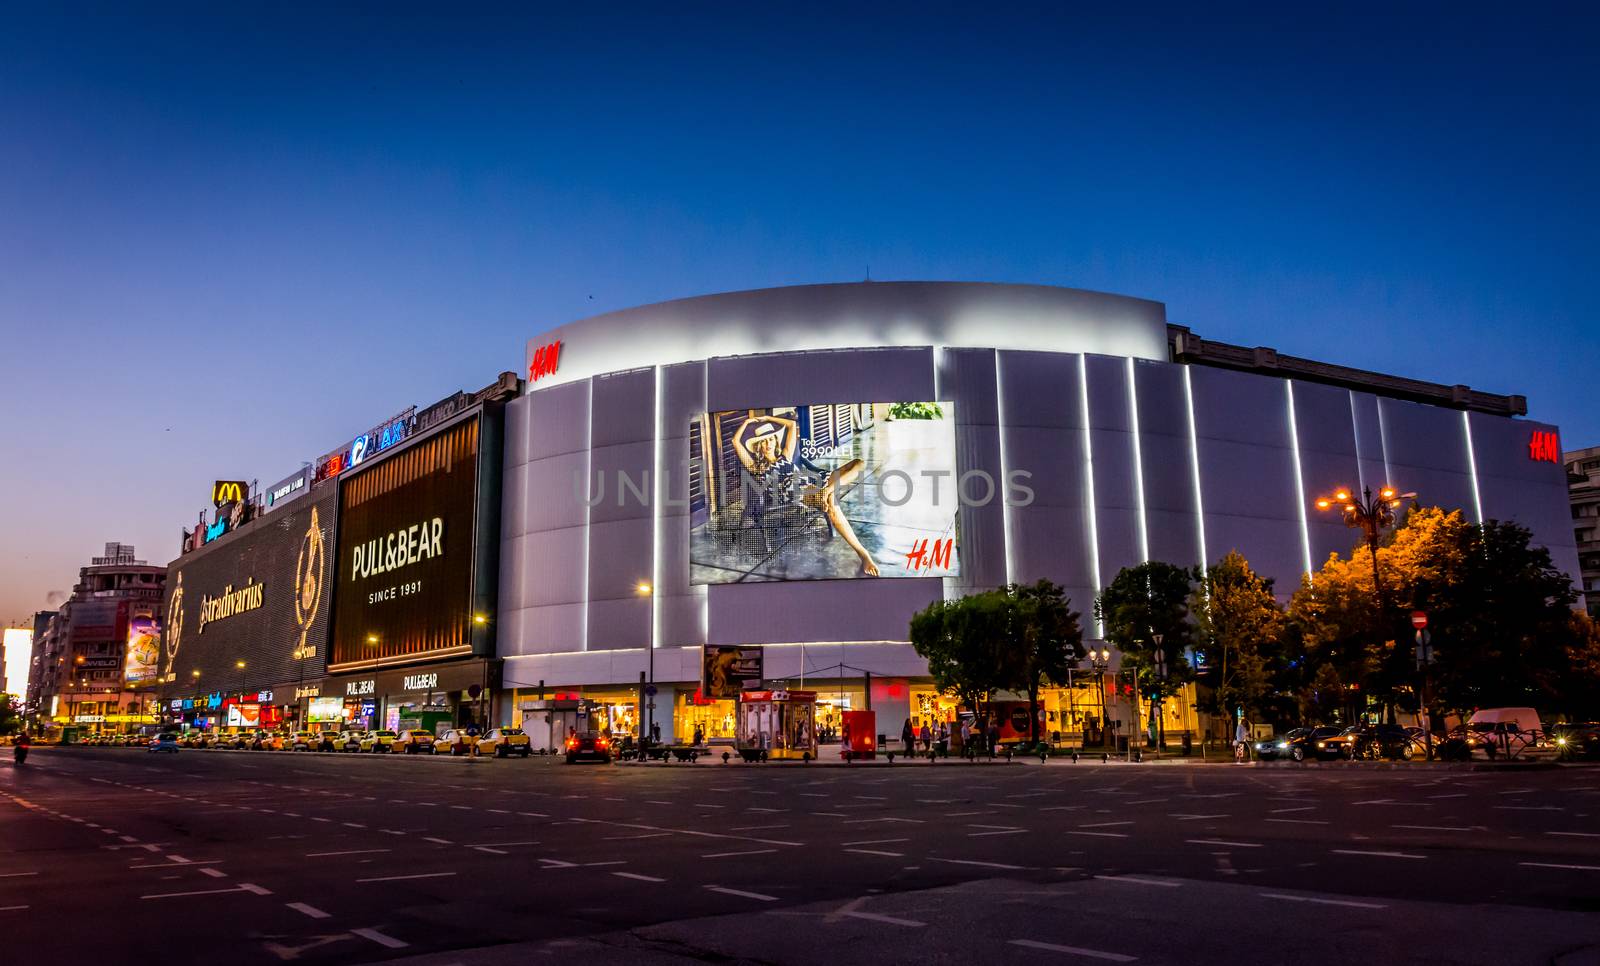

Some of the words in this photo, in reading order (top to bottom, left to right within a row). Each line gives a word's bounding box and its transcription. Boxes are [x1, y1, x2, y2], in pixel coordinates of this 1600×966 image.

[529, 339, 561, 383] H&M
[801, 446, 834, 459] 39,90
[1529, 430, 1558, 464] H&M
[352, 517, 443, 581] PULL&BEAR
[905, 538, 953, 570] H&M
[368, 587, 397, 604] SINCE
[400, 581, 421, 596] 1991
[404, 673, 437, 690] PULL&BEAR
